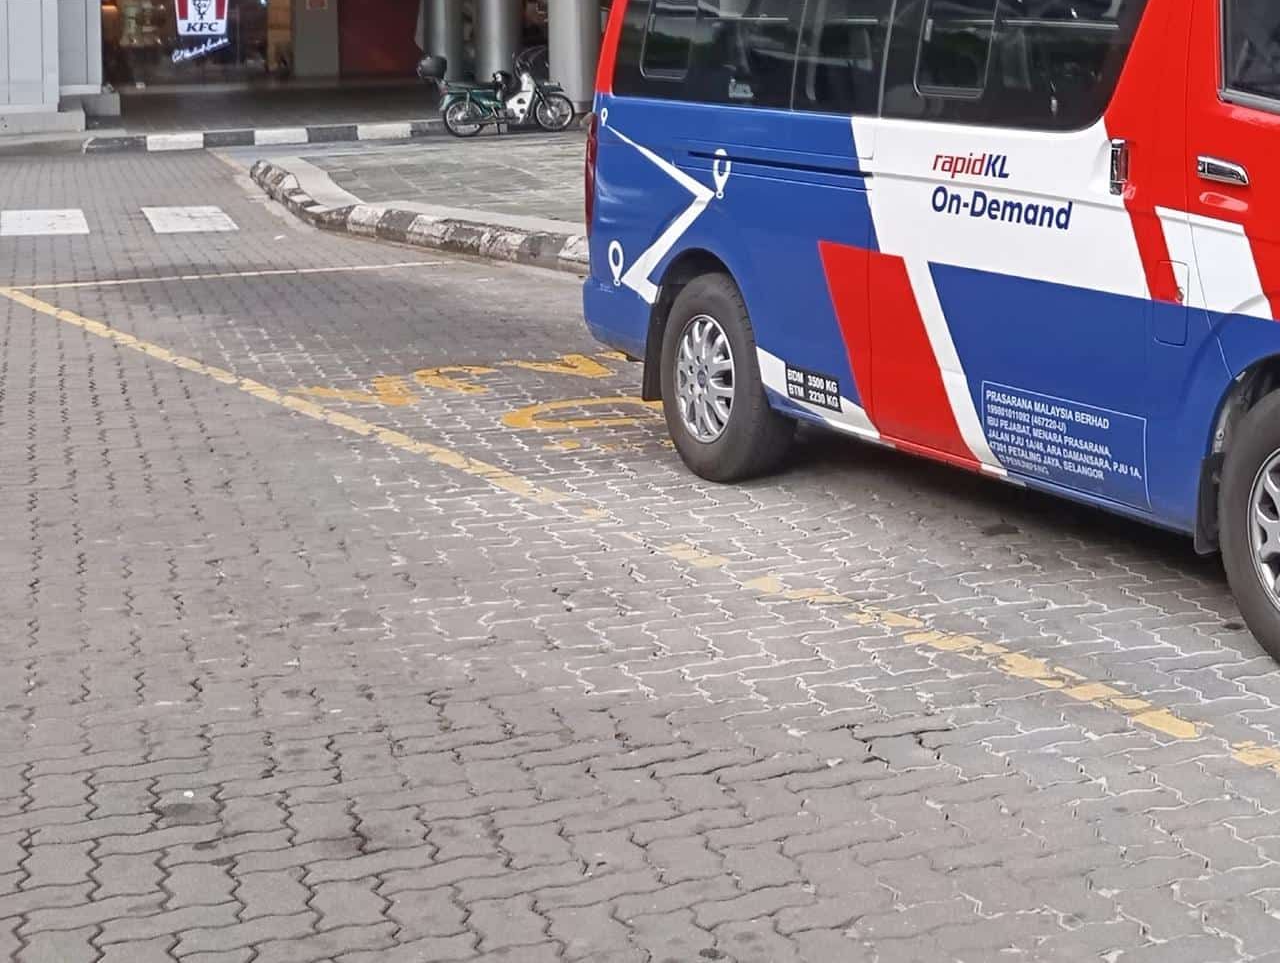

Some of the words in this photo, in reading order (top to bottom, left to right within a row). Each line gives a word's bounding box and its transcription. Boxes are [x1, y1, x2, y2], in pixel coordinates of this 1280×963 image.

[186, 21, 219, 33] KFC
[932, 152, 1010, 179] rapidKL
[932, 186, 1073, 230] On-Demand
[825, 379, 838, 394] KG
[985, 389, 1033, 411] PRASARANA
[1033, 401, 1074, 422] MALAYSIA
[1074, 411, 1110, 430] BERHAD
[1046, 444, 1062, 457] ARA
[1112, 461, 1129, 475] PJU
